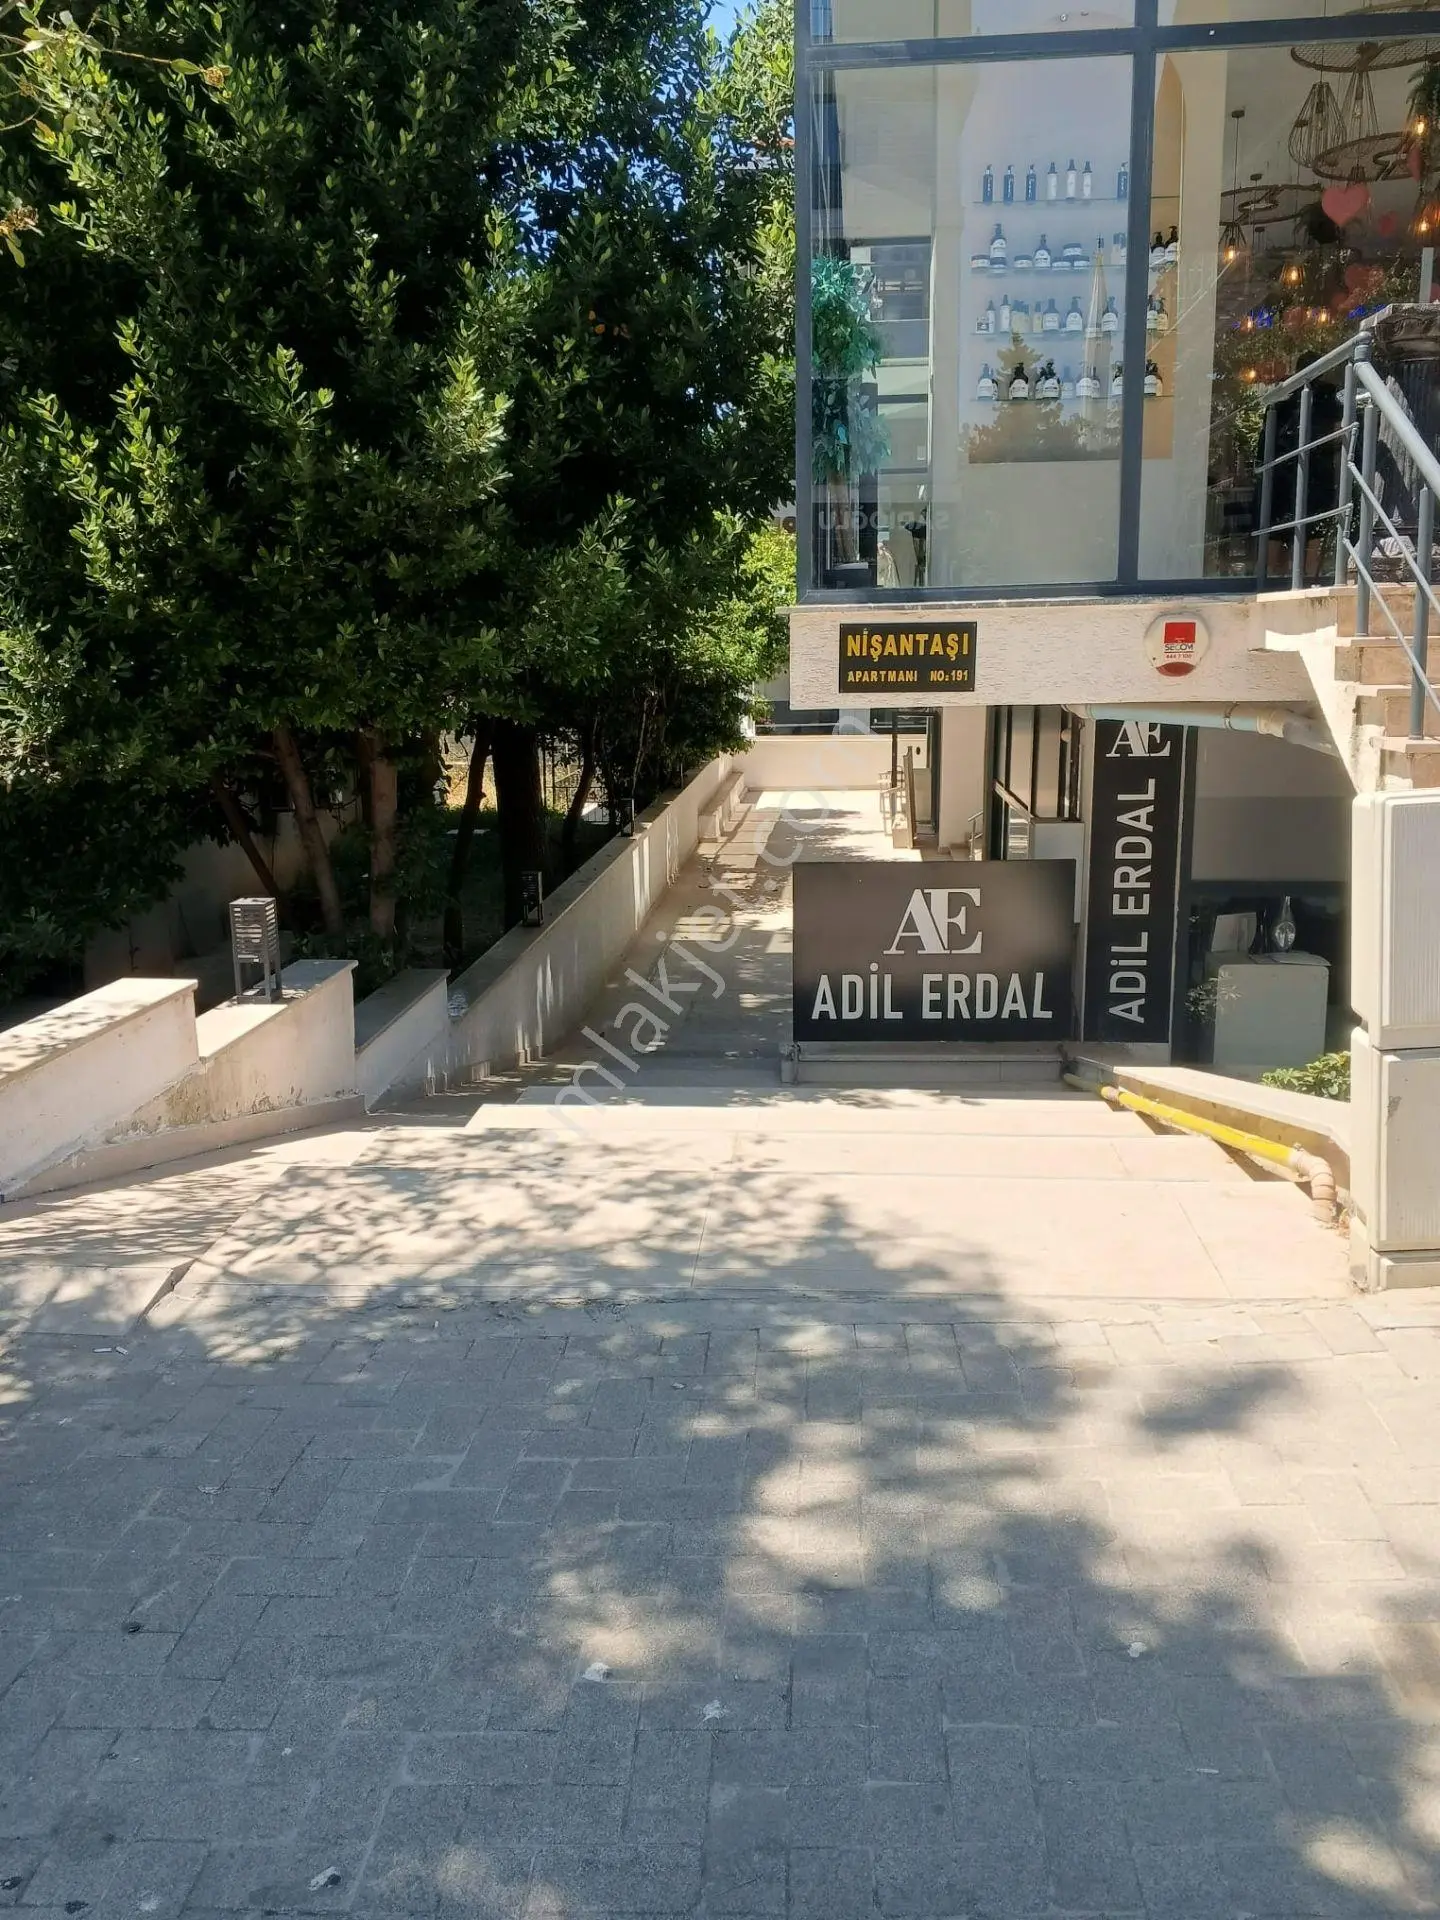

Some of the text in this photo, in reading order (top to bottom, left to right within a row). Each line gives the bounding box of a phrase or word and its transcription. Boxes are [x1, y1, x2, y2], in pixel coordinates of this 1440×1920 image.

[846, 627, 969, 662] NİŞANTAŞI
[847, 669, 969, 682] APARTMANI NO:191
[1112, 778, 1156, 916] ERDAL
[883, 887, 983, 955] AE
[811, 962, 1053, 1020] ADİL ERDAL
